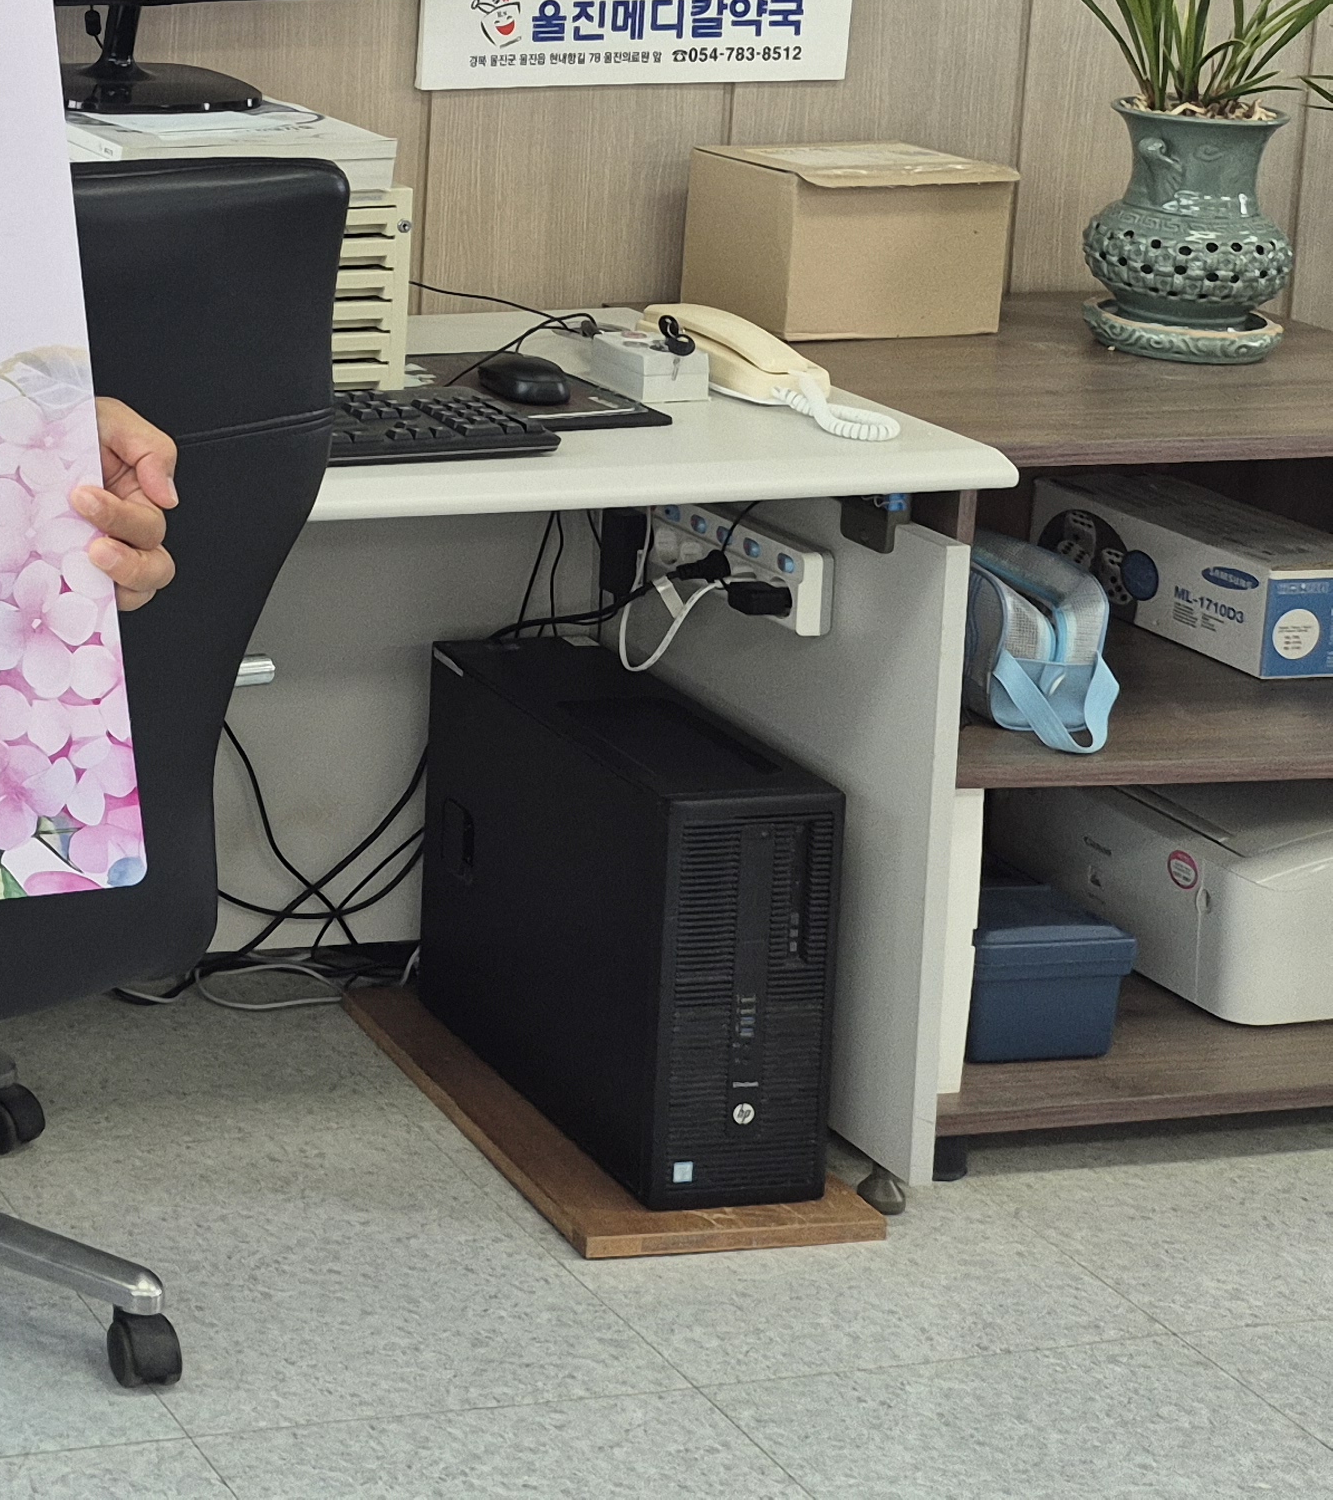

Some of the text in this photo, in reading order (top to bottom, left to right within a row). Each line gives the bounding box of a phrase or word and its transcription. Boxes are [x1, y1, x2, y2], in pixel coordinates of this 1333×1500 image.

[469, 55, 488, 68] 경북
[490, 54, 518, 67] 울진군
[519, 53, 546, 66] 울진읍
[588, 52, 601, 64] 78
[603, 50, 650, 65] 울진의료원
[1174, 585, 1245, 624] ML-1710D3
